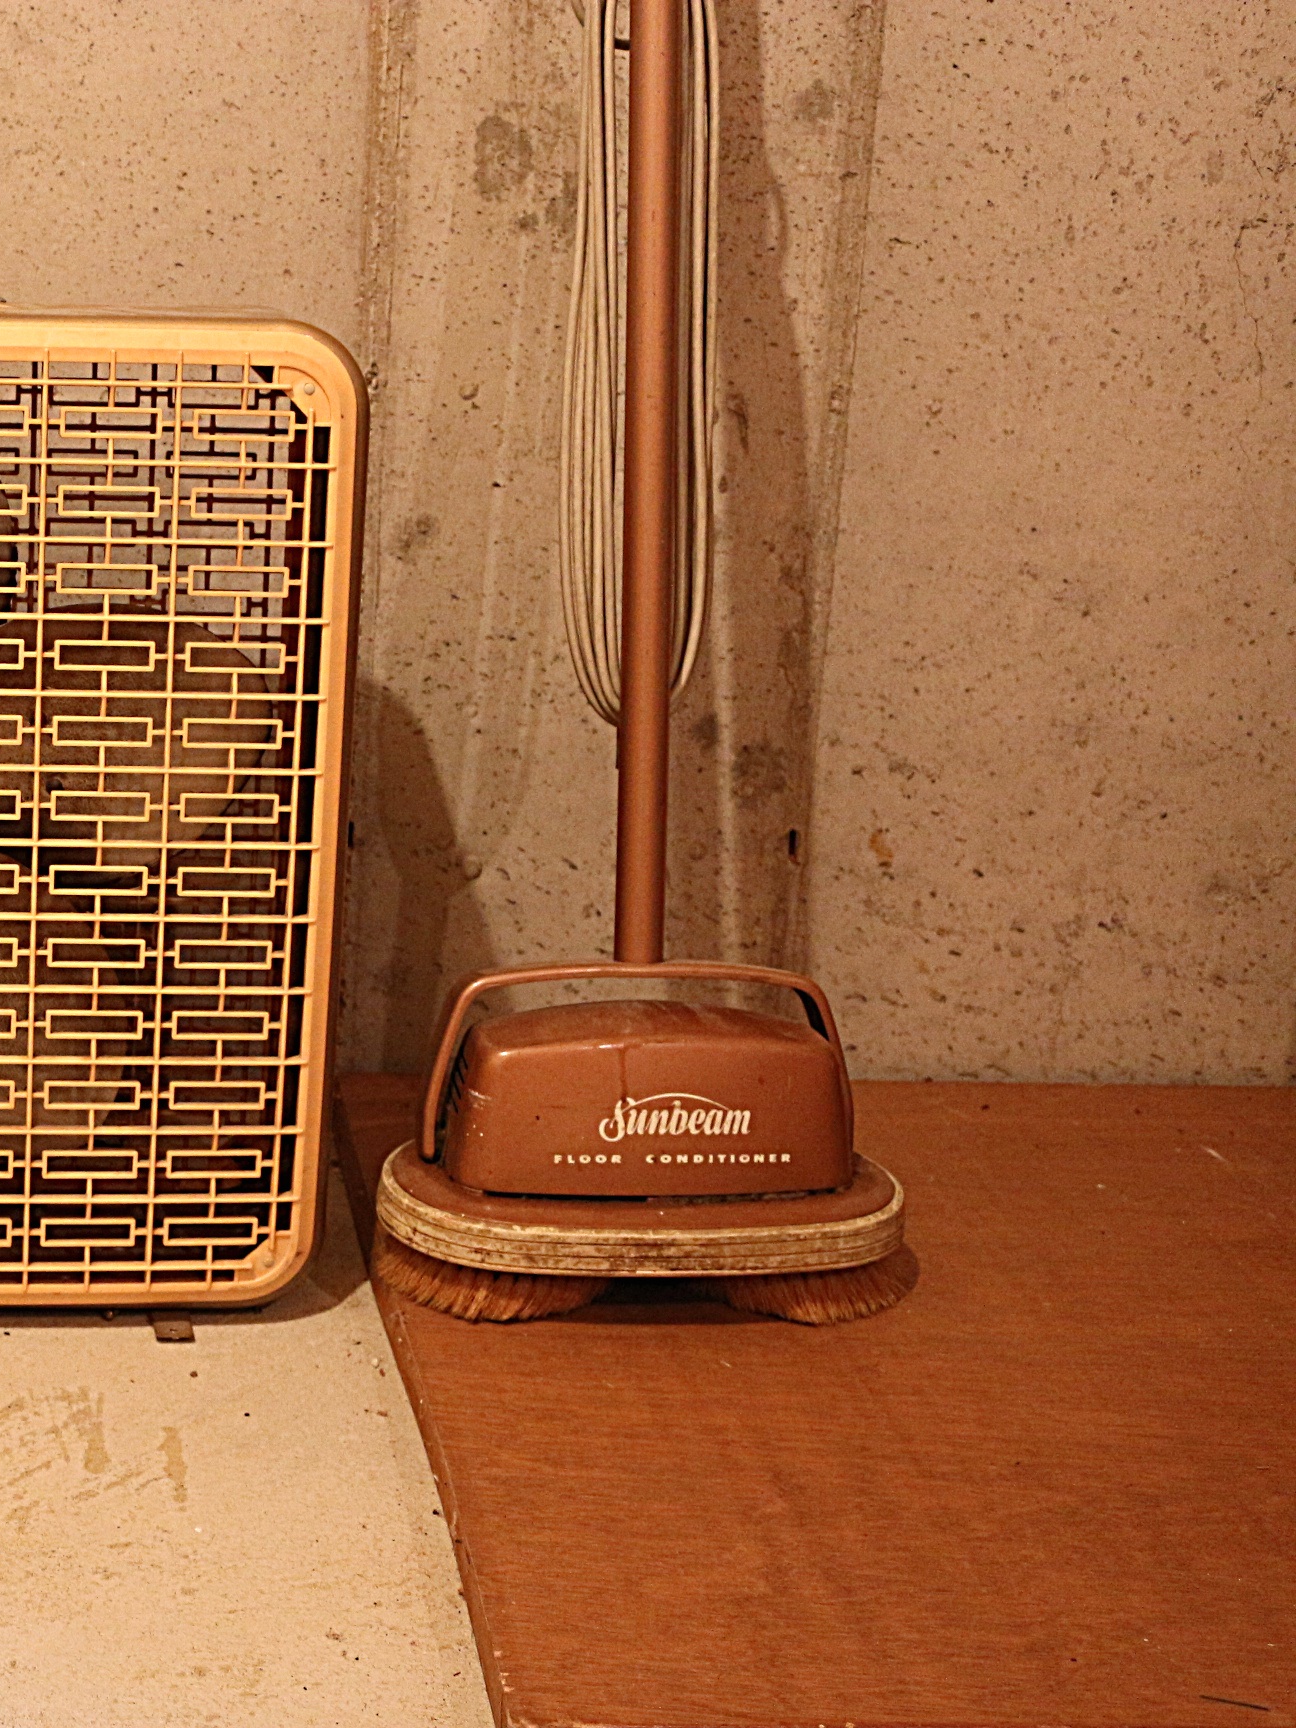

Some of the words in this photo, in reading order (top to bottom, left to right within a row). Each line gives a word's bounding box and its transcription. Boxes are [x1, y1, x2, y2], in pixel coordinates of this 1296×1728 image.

[598, 1093, 752, 1142] Sunbeam
[553, 1153, 623, 1165] FLOOR
[645, 1152, 792, 1165] CONDITIONER
